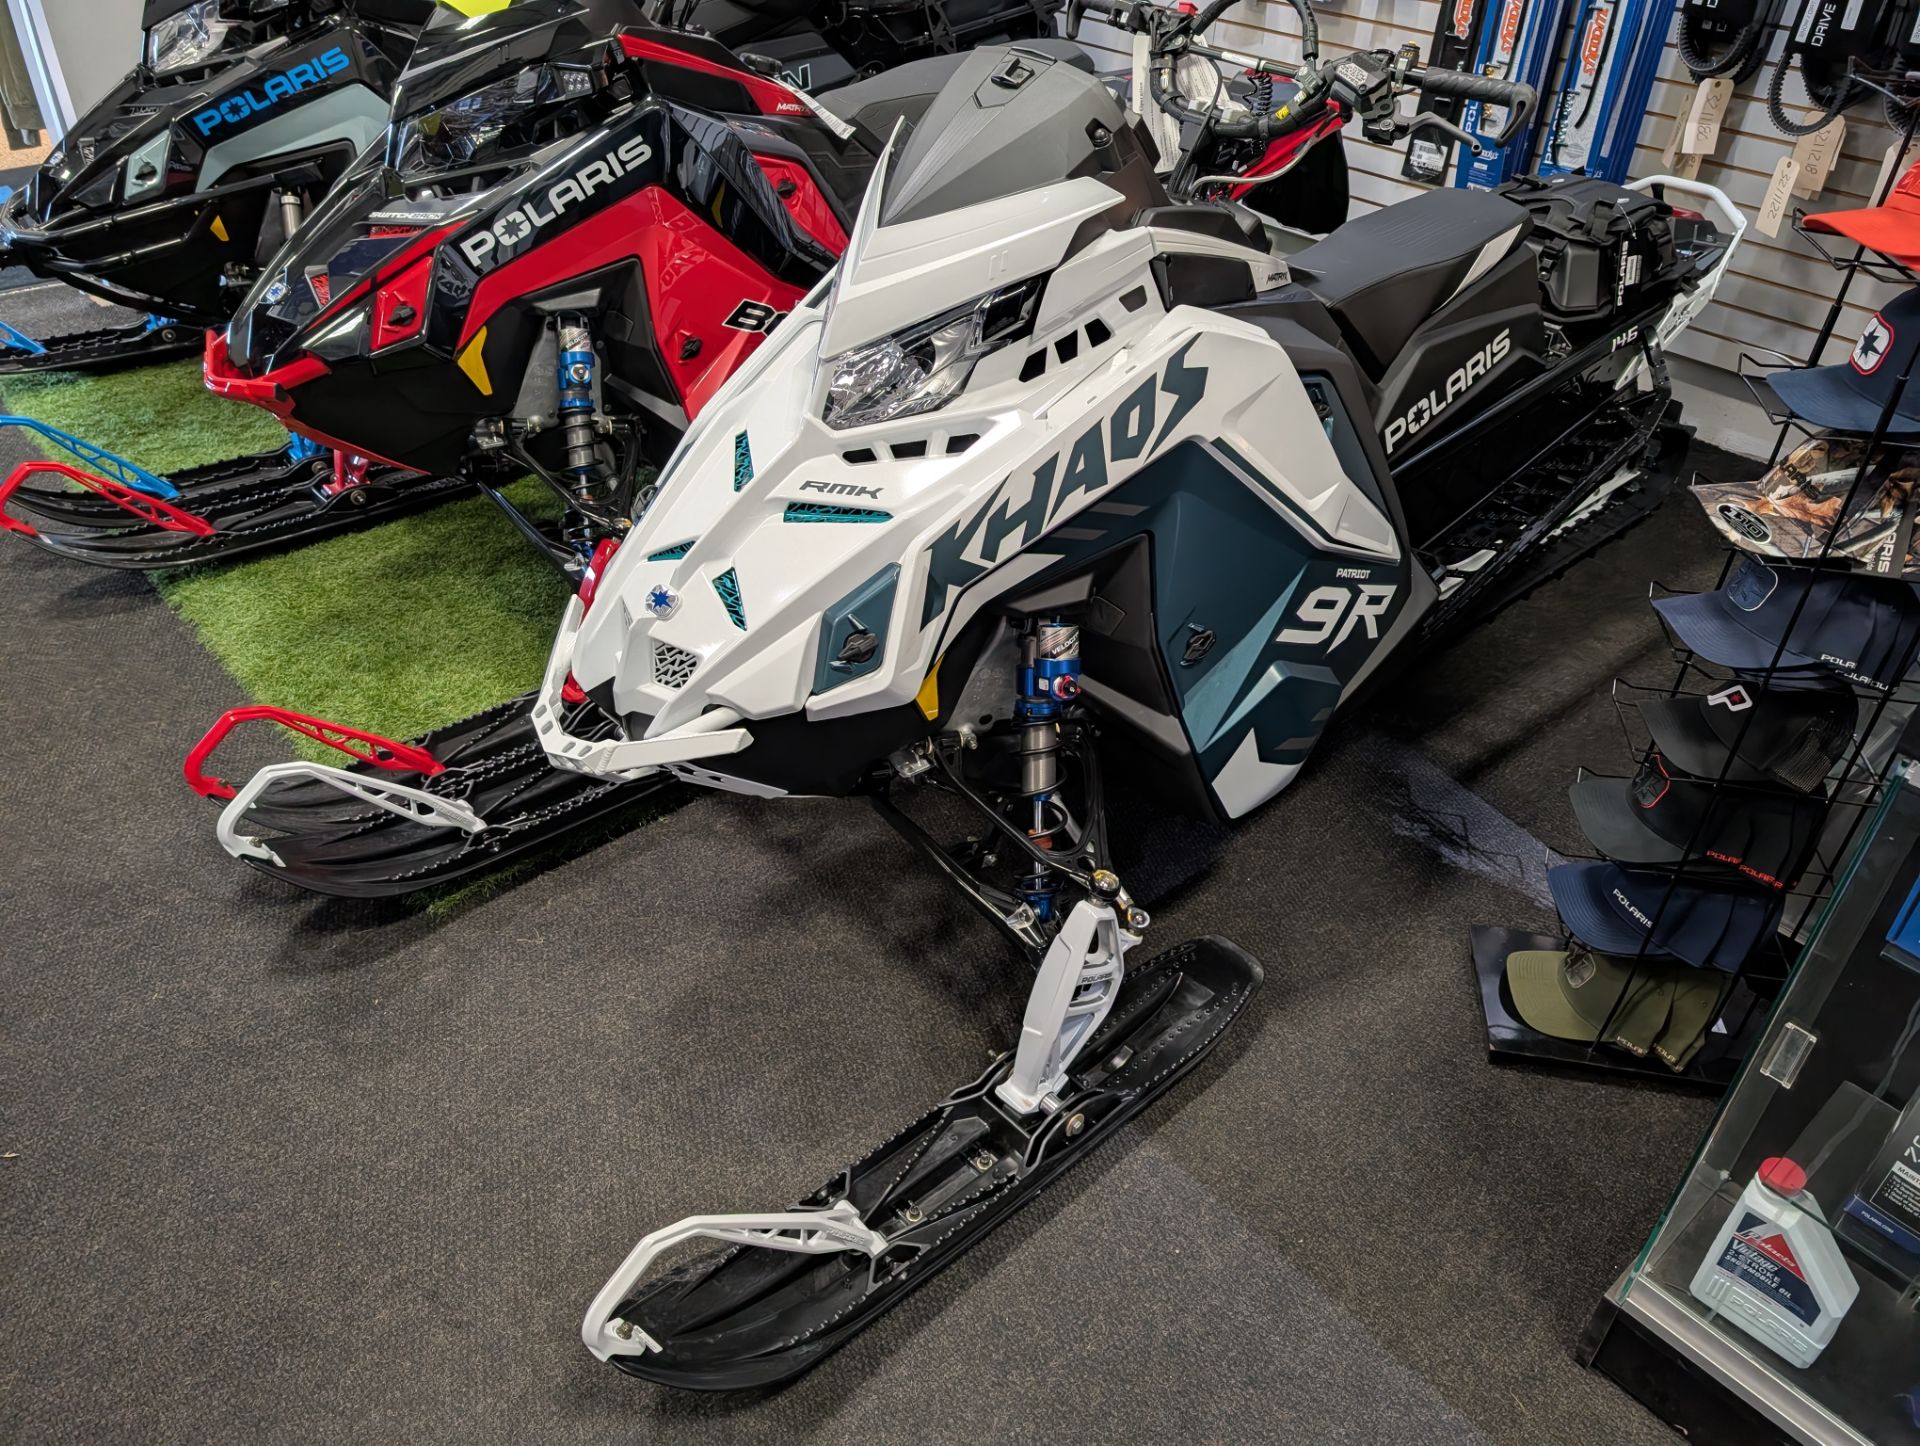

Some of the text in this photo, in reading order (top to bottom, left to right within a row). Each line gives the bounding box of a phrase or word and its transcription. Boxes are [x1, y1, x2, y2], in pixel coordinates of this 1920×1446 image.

[1811, 2, 1837, 47] DRIVE
[193, 46, 350, 136] POLARIS
[460, 134, 652, 267] POLARIS
[1617, 240, 1629, 306] POLARIS
[1611, 325, 1639, 352] 146
[1384, 328, 1511, 455] POLARIS
[799, 480, 884, 500] RMK
[920, 331, 1209, 632] KHAOS
[1336, 568, 1371, 579] PATRIOT
[1275, 584, 1398, 656] 9R
[1612, 888, 1654, 929] POLARIS
[1724, 1255, 1793, 1299] SNOWMOBILE OIL
[1728, 1248, 1782, 1283] 2-STROKE
[1732, 1239, 1780, 1272] Vintage
